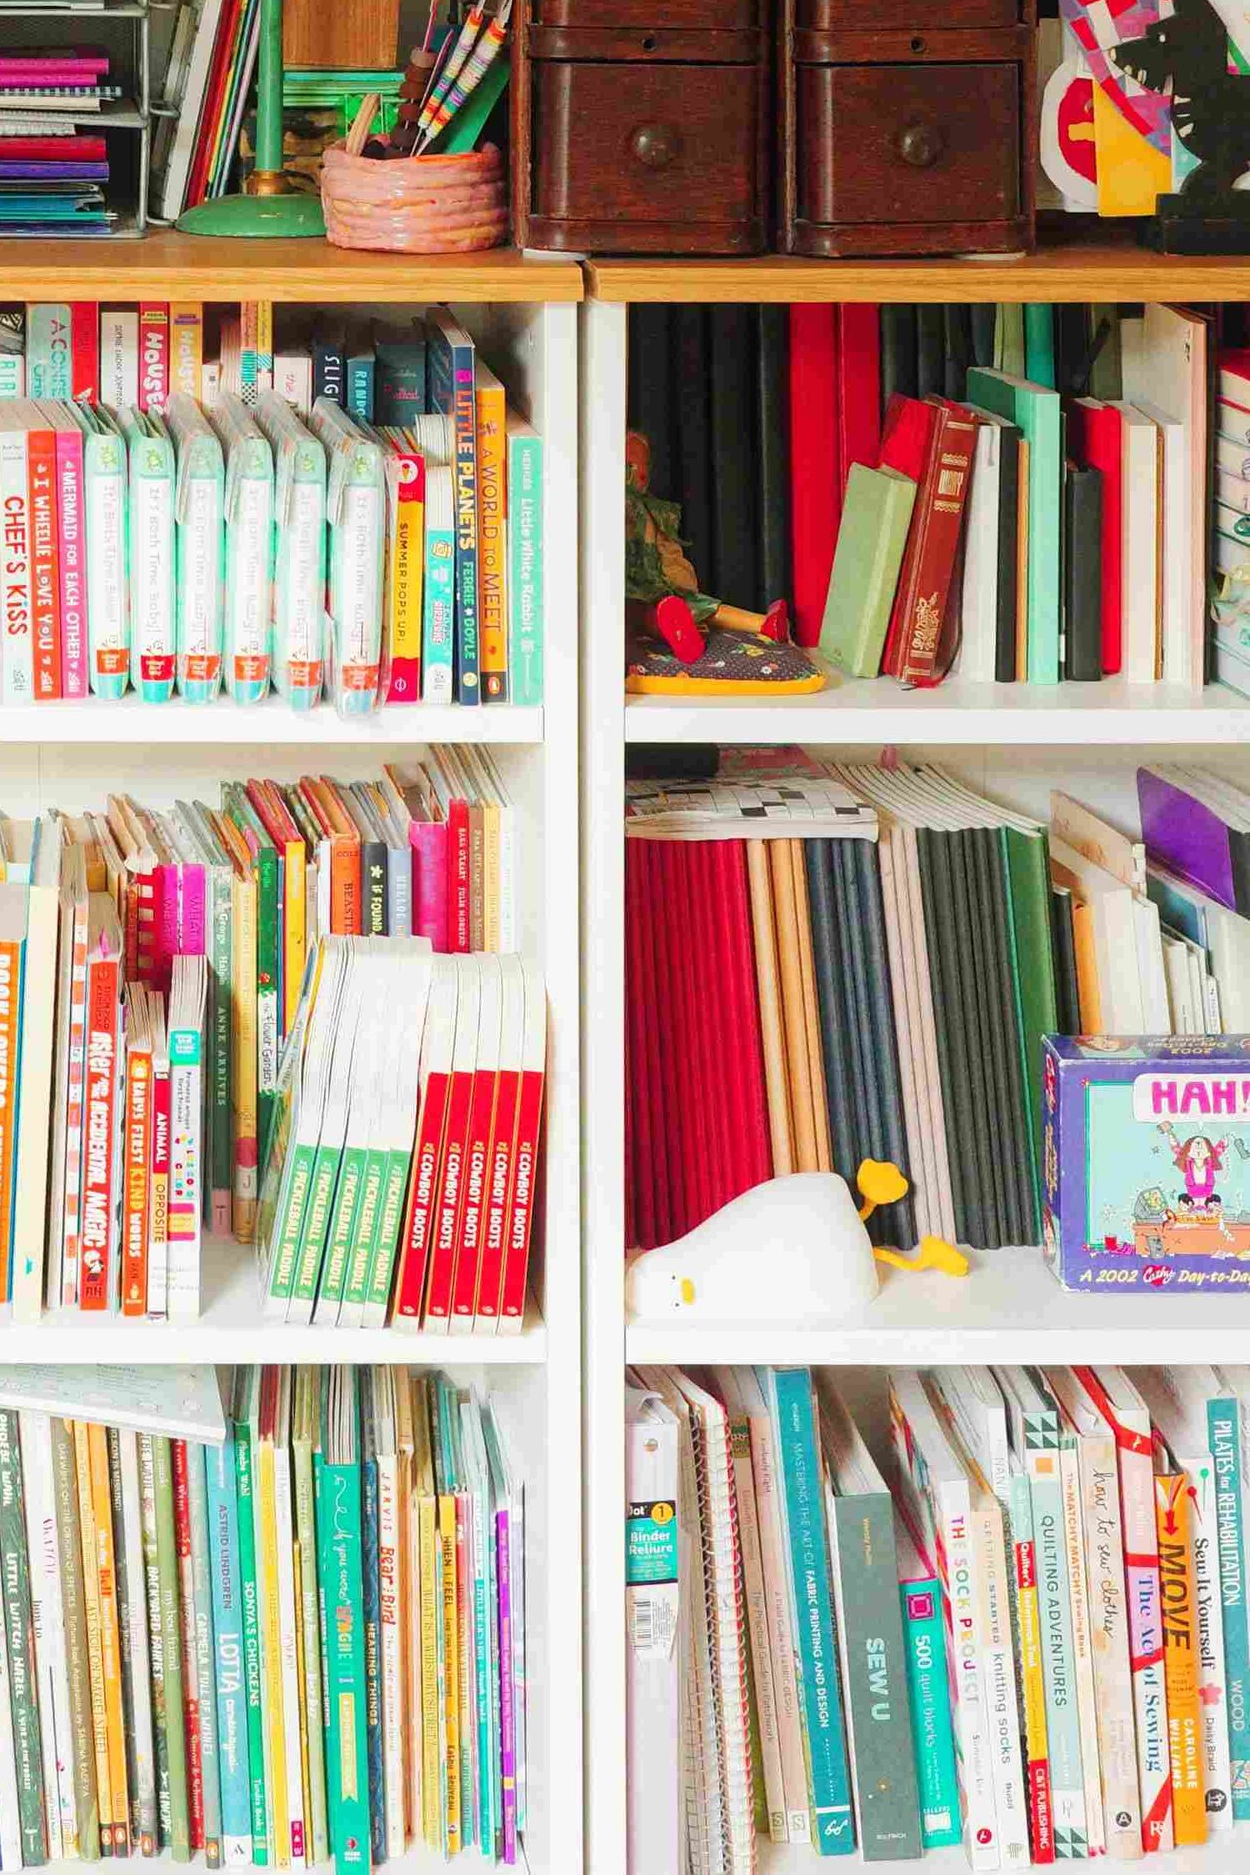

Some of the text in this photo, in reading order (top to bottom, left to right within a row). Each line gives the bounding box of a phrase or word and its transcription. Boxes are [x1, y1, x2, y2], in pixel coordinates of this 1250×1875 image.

[4, 496, 27, 574] CHEF'S
[63, 472, 79, 661] MERMAID FOR EACH OTHER
[457, 389, 476, 659] LITTLE PLANETS FERRIE DOYLE
[481, 464, 501, 631] WORLD MEET
[398, 522, 409, 616] SUMMER POPS
[215, 1049, 228, 1107] ARRIVES
[156, 1112, 168, 1162] ANIMAL
[154, 1184, 165, 1244] OPPOSITE
[411, 1153, 434, 1250] COWBOY BOOTS
[276, 1243, 295, 1286] PADDLE
[1096, 1270, 1138, 1283] 2002
[217, 1503, 229, 1548] ASTRID
[630, 1531, 670, 1542] Binder
[630, 1543, 673, 1554] Reliure
[1213, 1419, 1240, 1607] PILATES REHABILITATION
[950, 1516, 979, 1704] THE SOCK PROJECT
[1041, 1515, 1067, 1708] QUILTING ADVENTURES
[1158, 1543, 1191, 1651] MOVE
[1194, 1537, 1216, 1670] Sew Yourself
[218, 1631, 241, 1695] LOTTA
[243, 1580, 260, 1708] SONYA'S CHICKENS
[366, 1622, 378, 1727] HEARING THINGS
[805, 1569, 828, 1729] FABRIC PRINTING DESIGN
[865, 1636, 891, 1723] SEW U
[915, 1634, 935, 1704] 500 quilt
[1138, 1575, 1161, 1773] The Sewing
[1229, 1679, 1243, 1733] WOOD
[1168, 1719, 1184, 1789] WILLIAMS
[1183, 1717, 1198, 1789] CAROLINE
